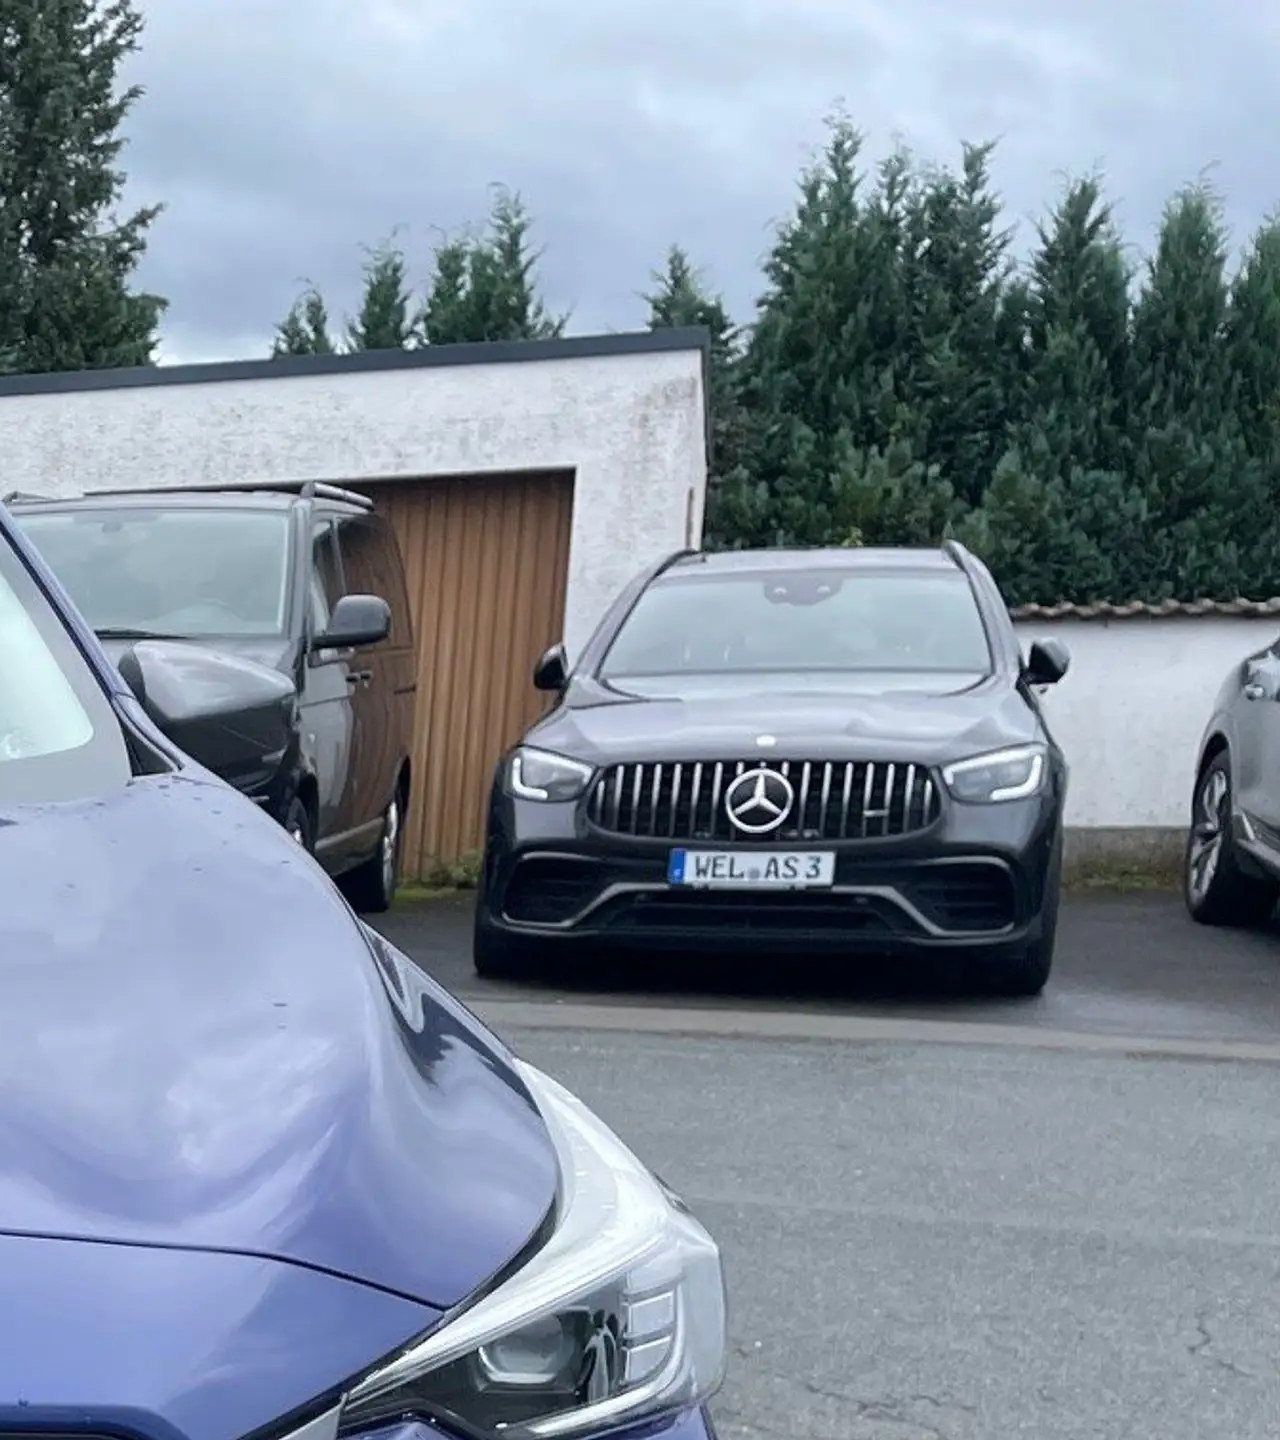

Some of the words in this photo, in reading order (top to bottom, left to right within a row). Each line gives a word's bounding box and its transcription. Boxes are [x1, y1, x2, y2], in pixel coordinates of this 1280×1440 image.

[695, 855, 745, 879] WEL
[765, 855, 800, 879] AS
[806, 856, 821, 880] 3
